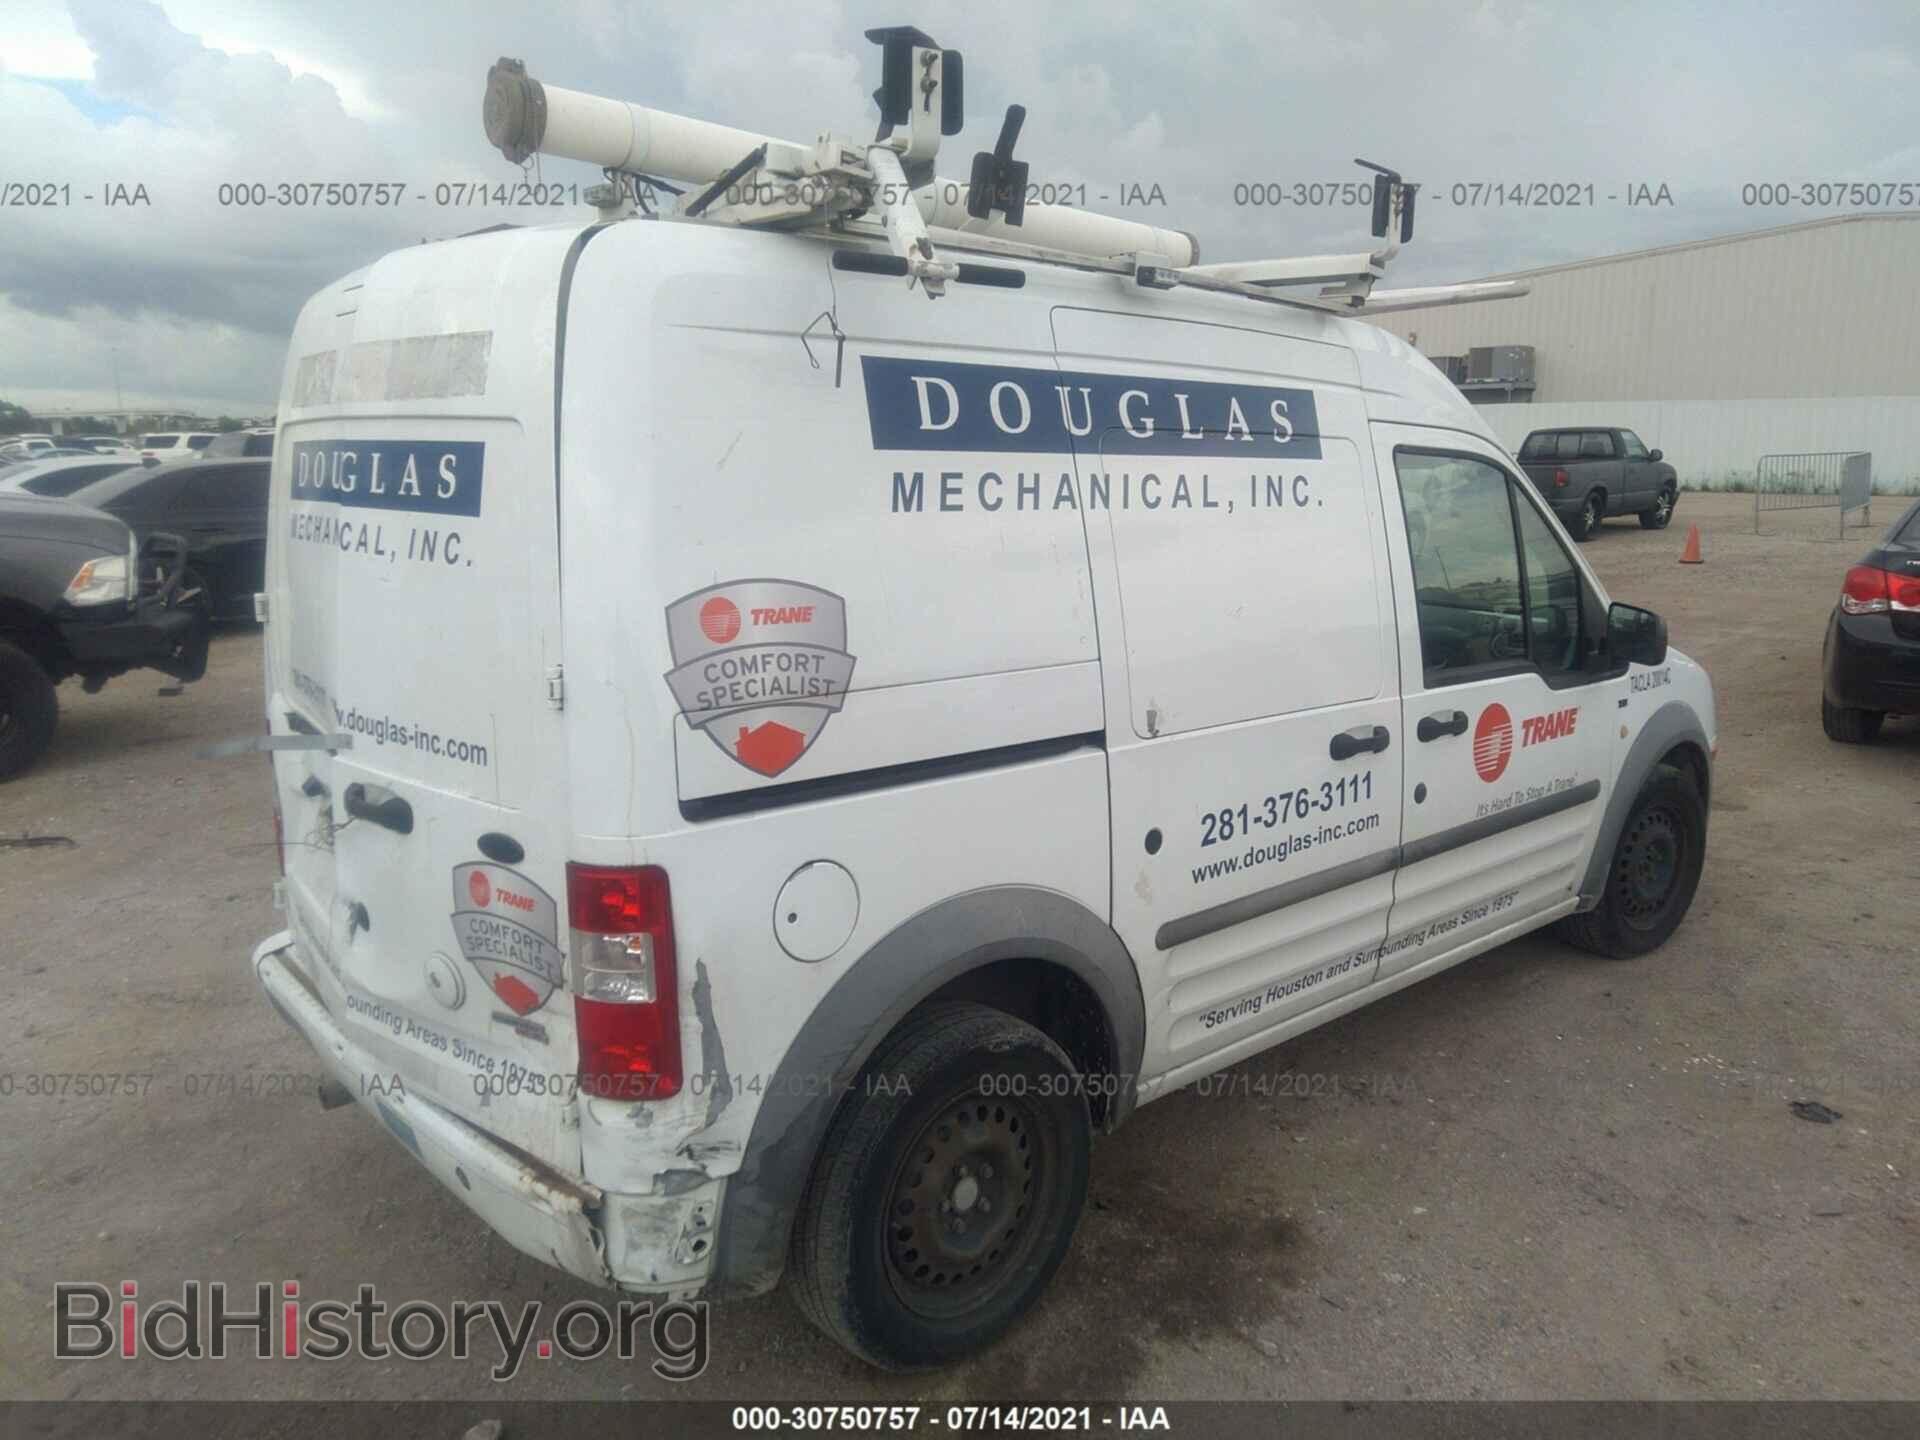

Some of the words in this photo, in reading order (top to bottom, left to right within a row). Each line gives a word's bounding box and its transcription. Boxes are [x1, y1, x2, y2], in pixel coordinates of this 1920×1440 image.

[910, 376, 1295, 443] DOUGLAS
[298, 450, 458, 498] DOUGLAS
[891, 472, 1235, 513] MECHANICAL,
[1250, 474, 1324, 508] INC.
[408, 528, 473, 567] INC.
[751, 606, 816, 626] TRANE
[703, 652, 825, 684] COMFORT
[696, 676, 836, 709] SPECIALIST
[1520, 707, 1579, 748] TRANE
[1200, 770, 1372, 848] 281-376-3111
[1191, 813, 1380, 884] www.douglas-inc.com
[496, 887, 537, 912] TRANE
[470, 918, 545, 954] COMFORT
[1265, 971, 1324, 1004] Houston
[1327, 956, 1352, 980] and
[1353, 930, 1427, 967] Surrounding
[1426, 917, 1458, 939] Areas
[1460, 904, 1489, 925] Since
[465, 936, 553, 979] SPECIALIST
[405, 1017, 448, 1051] Areas
[452, 1038, 495, 1075] Since
